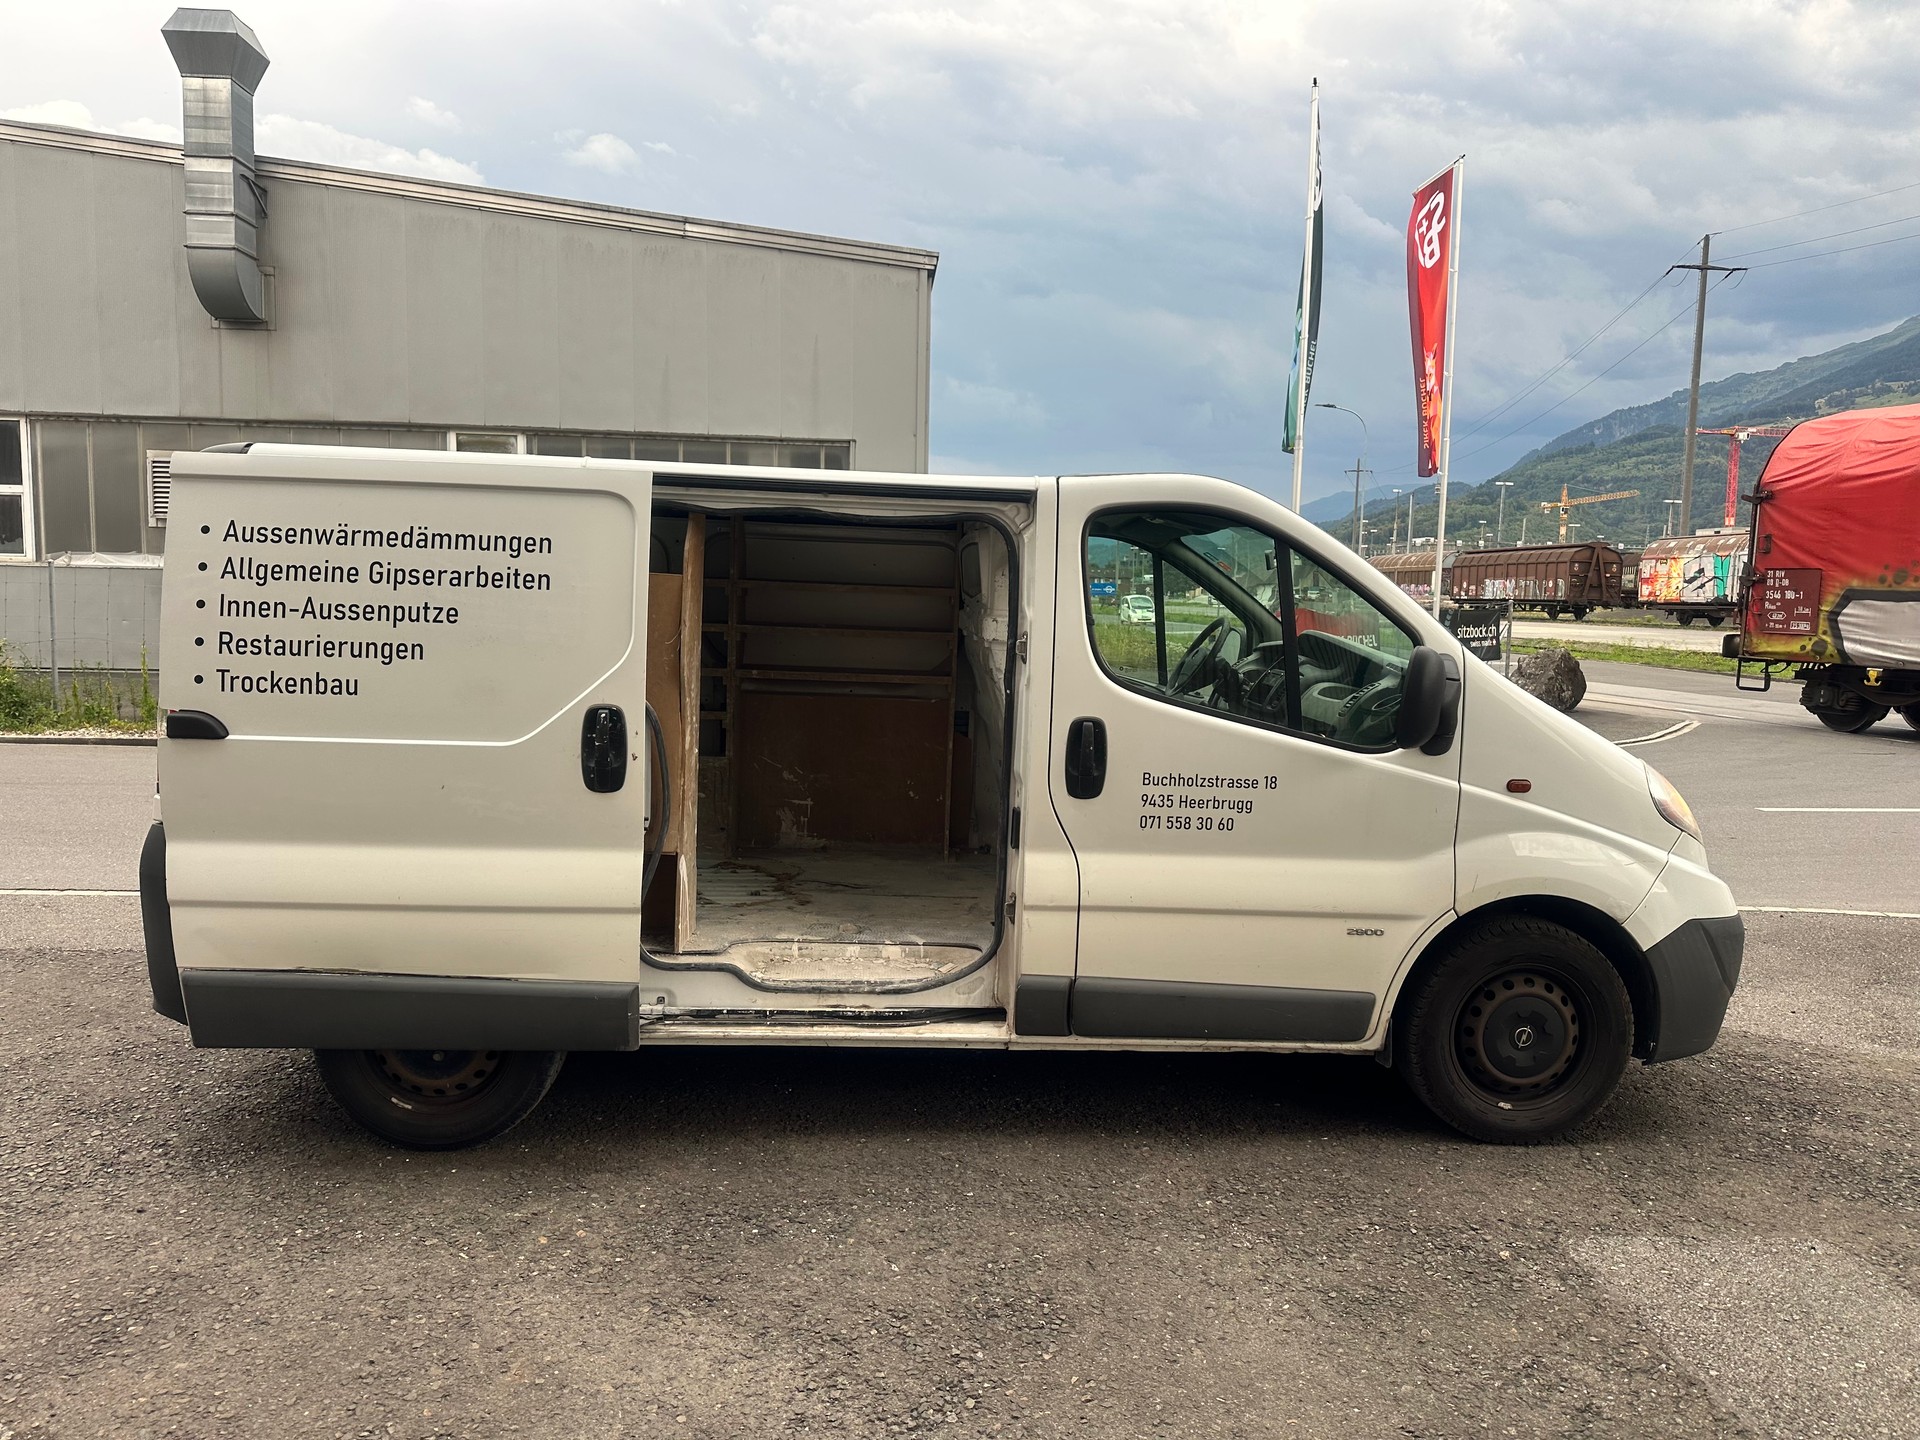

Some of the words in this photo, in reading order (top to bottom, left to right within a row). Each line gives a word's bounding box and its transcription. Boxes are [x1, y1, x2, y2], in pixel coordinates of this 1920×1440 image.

[222, 519, 552, 559] Aussenwärmedämmungen
[220, 556, 359, 587] Allgemeine
[369, 560, 551, 592] Gipserarbeiten
[1775, 570, 1786, 578] RIV
[1765, 590, 1781, 599] 3546
[219, 593, 459, 629] Innen-Aussenputze
[1457, 623, 1497, 639] sitzbock.ch
[218, 631, 424, 666] Restaurierungen
[215, 668, 358, 696] Trockenbau
[1142, 771, 1259, 790] Buchholzstrasse
[1263, 775, 1278, 790] 18
[1141, 793, 1174, 809] 9435
[1178, 794, 1253, 815] Heerbrugg
[1139, 814, 1162, 830] 071
[1166, 815, 1192, 831] 558
[1195, 816, 1213, 831] 30
[1217, 817, 1235, 832] 60
